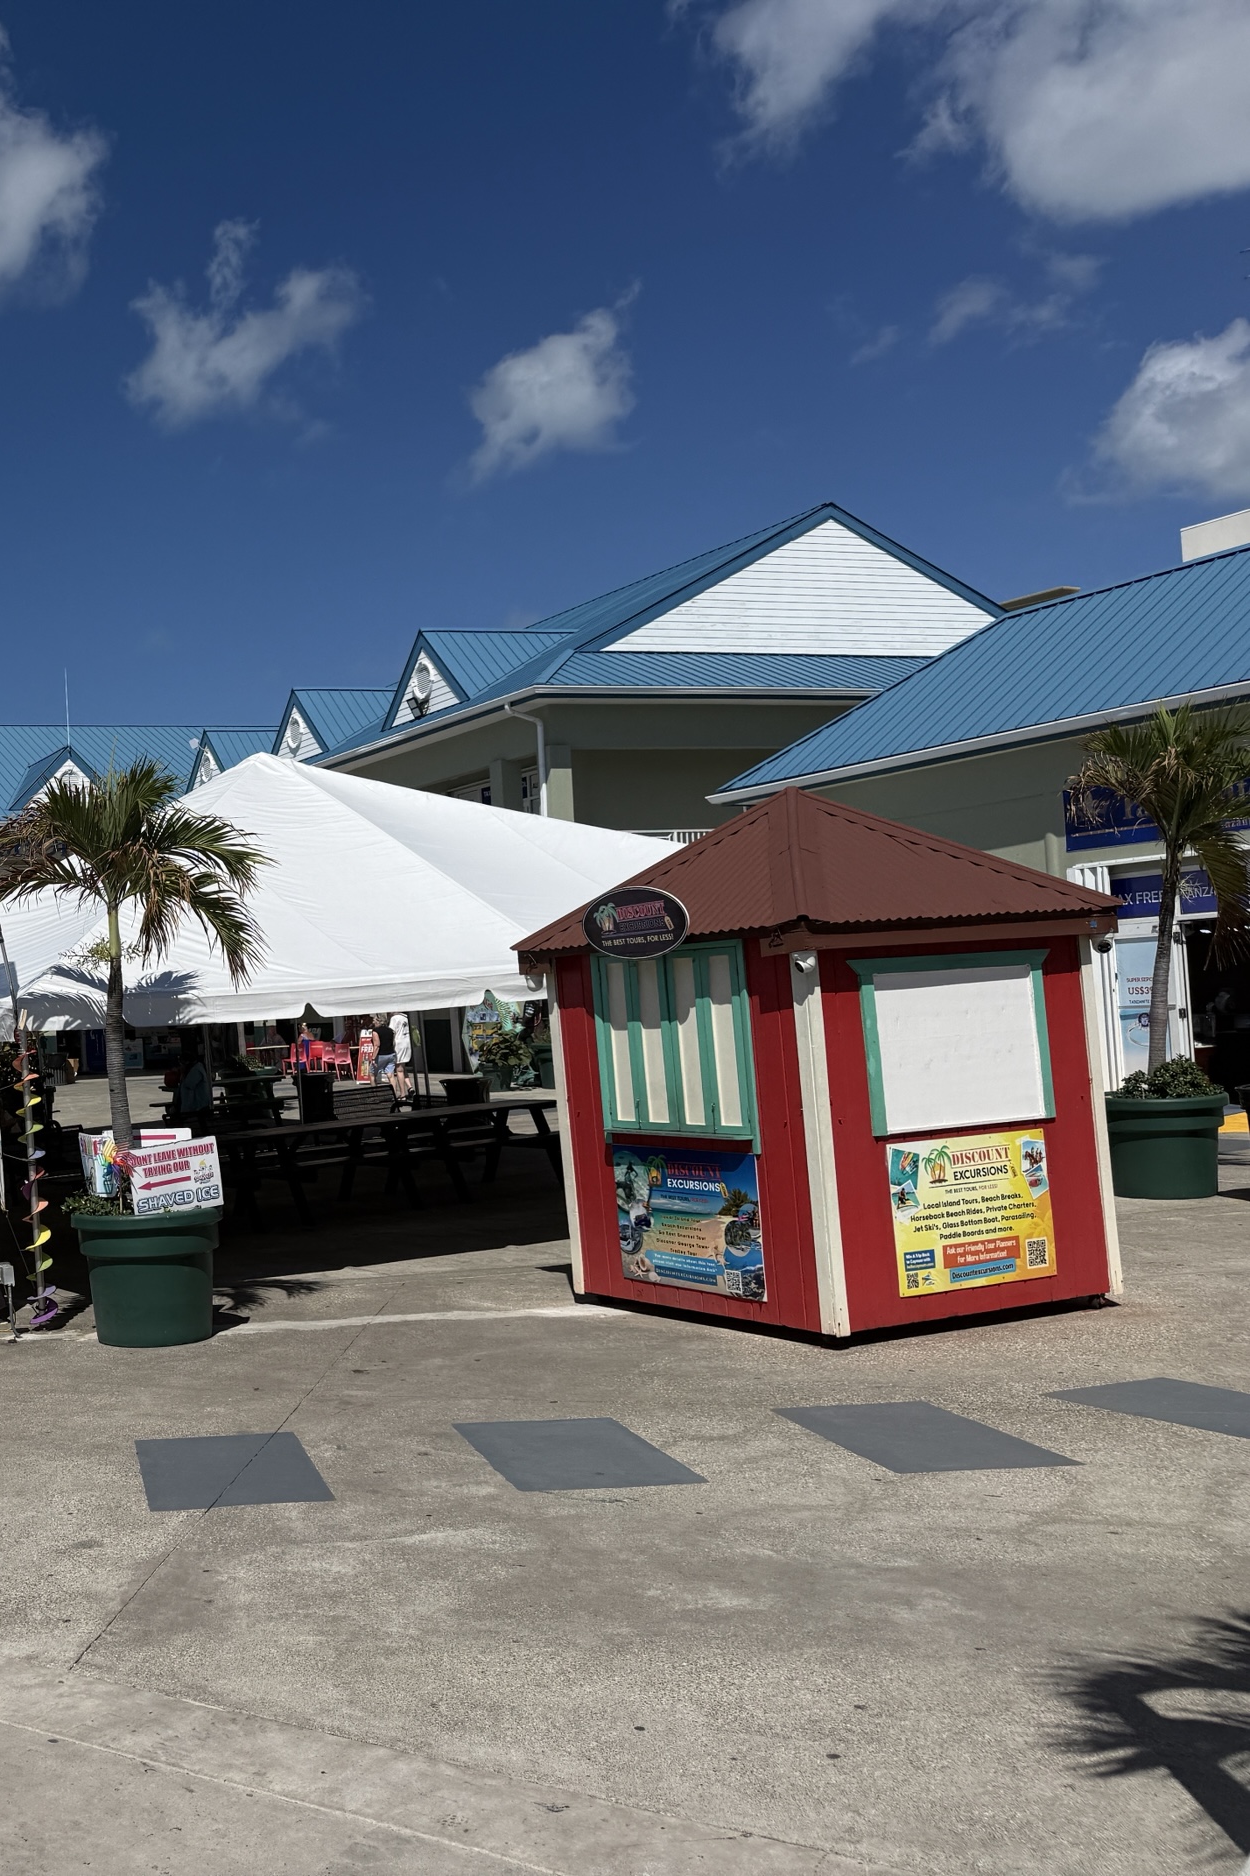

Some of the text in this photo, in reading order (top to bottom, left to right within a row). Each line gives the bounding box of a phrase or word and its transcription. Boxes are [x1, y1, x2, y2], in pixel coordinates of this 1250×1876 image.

[1113, 892, 1133, 906] AX
[616, 901, 665, 920] DISCOUNT
[627, 937, 647, 945] TOURS,
[659, 933, 674, 941] LESS!
[153, 1149, 177, 1162] LEAVE
[177, 1142, 215, 1158] WITHOUT
[951, 1146, 1010, 1166] DISCOUNT
[142, 1160, 191, 1178] TRYING OUR
[667, 1163, 721, 1179] DISCOUNT
[953, 1164, 1008, 1181] EXCURSIONS
[667, 1178, 720, 1192] EXCURSIONS
[137, 1184, 220, 1214] SHAVED ICE
[923, 1202, 941, 1210] Local
[942, 1199, 961, 1207] Island
[981, 1194, 1000, 1203] Beach
[910, 1212, 945, 1222] Horseback
[946, 1209, 966, 1218] Beach
[986, 1204, 1008, 1213] Private
[913, 1225, 924, 1233] Jet
[942, 1221, 960, 1229] Glass
[960, 1217, 983, 1227] Bottom
[939, 1231, 962, 1240] Paddle
[962, 1229, 985, 1237] Boards
[966, 1243, 985, 1253] Friendly
[985, 1241, 995, 1249] Tour
[996, 1239, 1016, 1248] Planners
[957, 1255, 965, 1263] for
[966, 1253, 979, 1262] More
